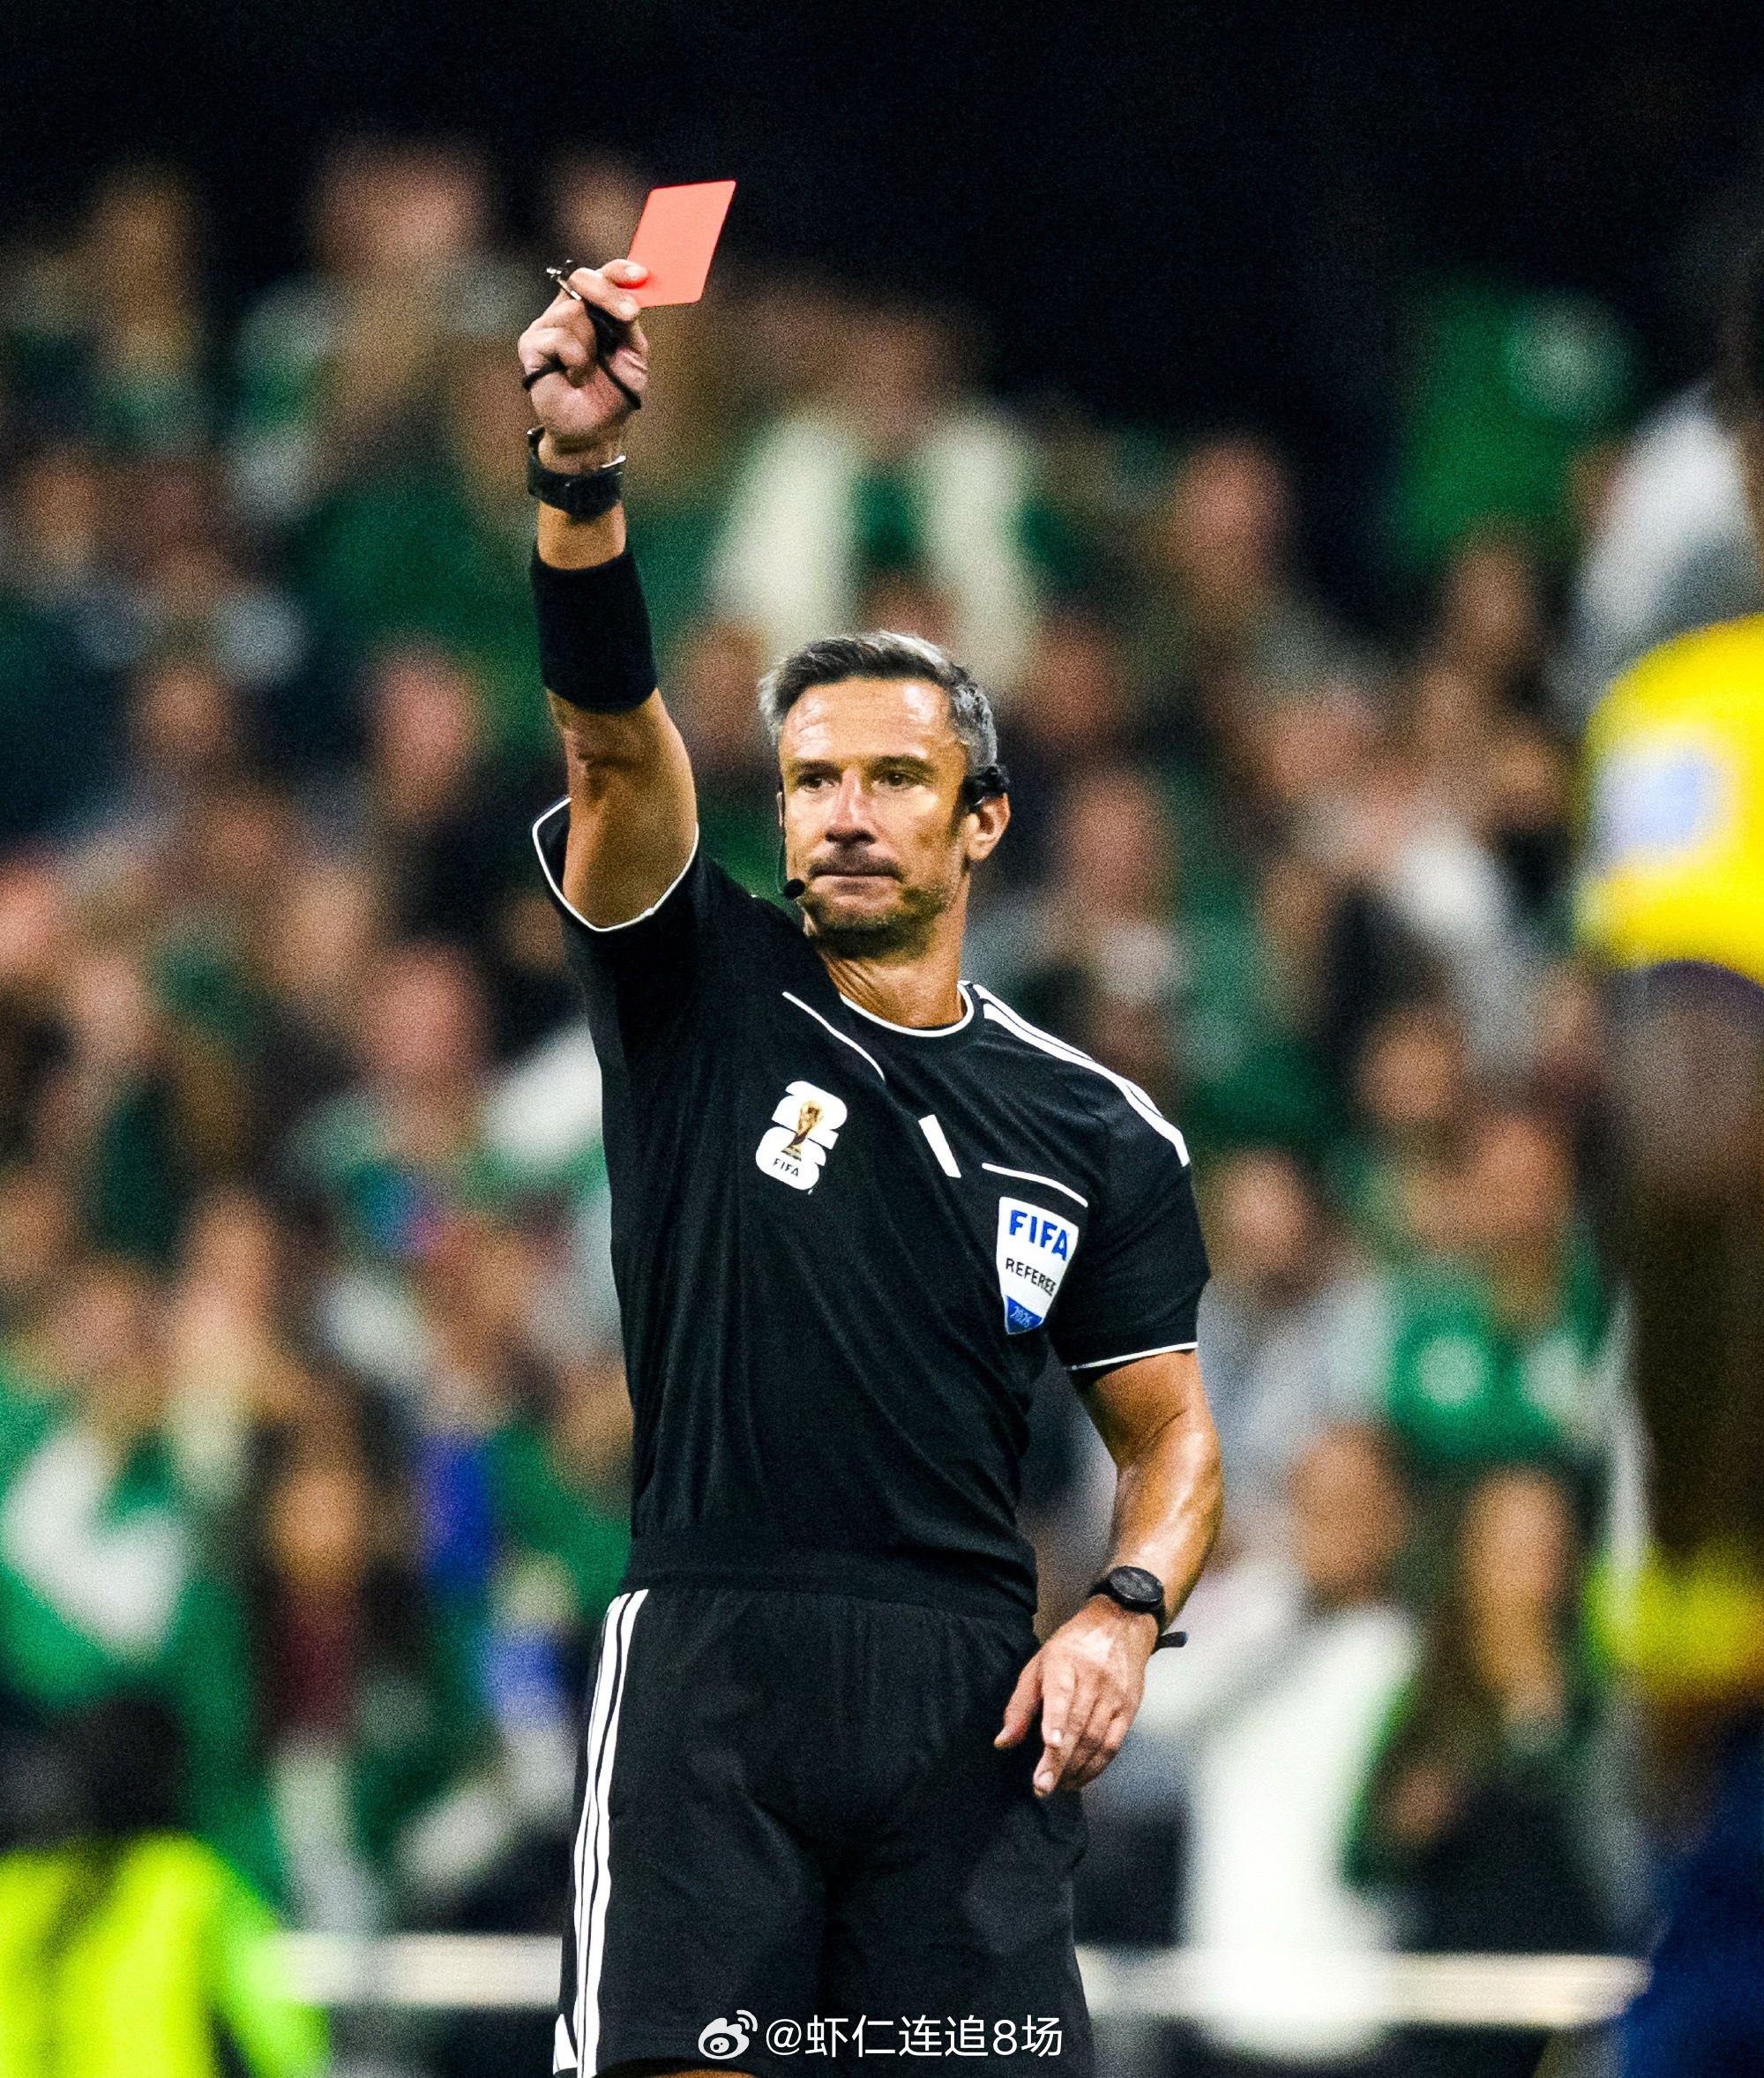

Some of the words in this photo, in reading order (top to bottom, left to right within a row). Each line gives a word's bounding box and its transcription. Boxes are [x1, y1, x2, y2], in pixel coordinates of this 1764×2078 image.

[773, 1157, 799, 1177] FIFA
[1009, 1209, 1067, 1261] FIFA
[1005, 1257, 1057, 1297] REFEREE
